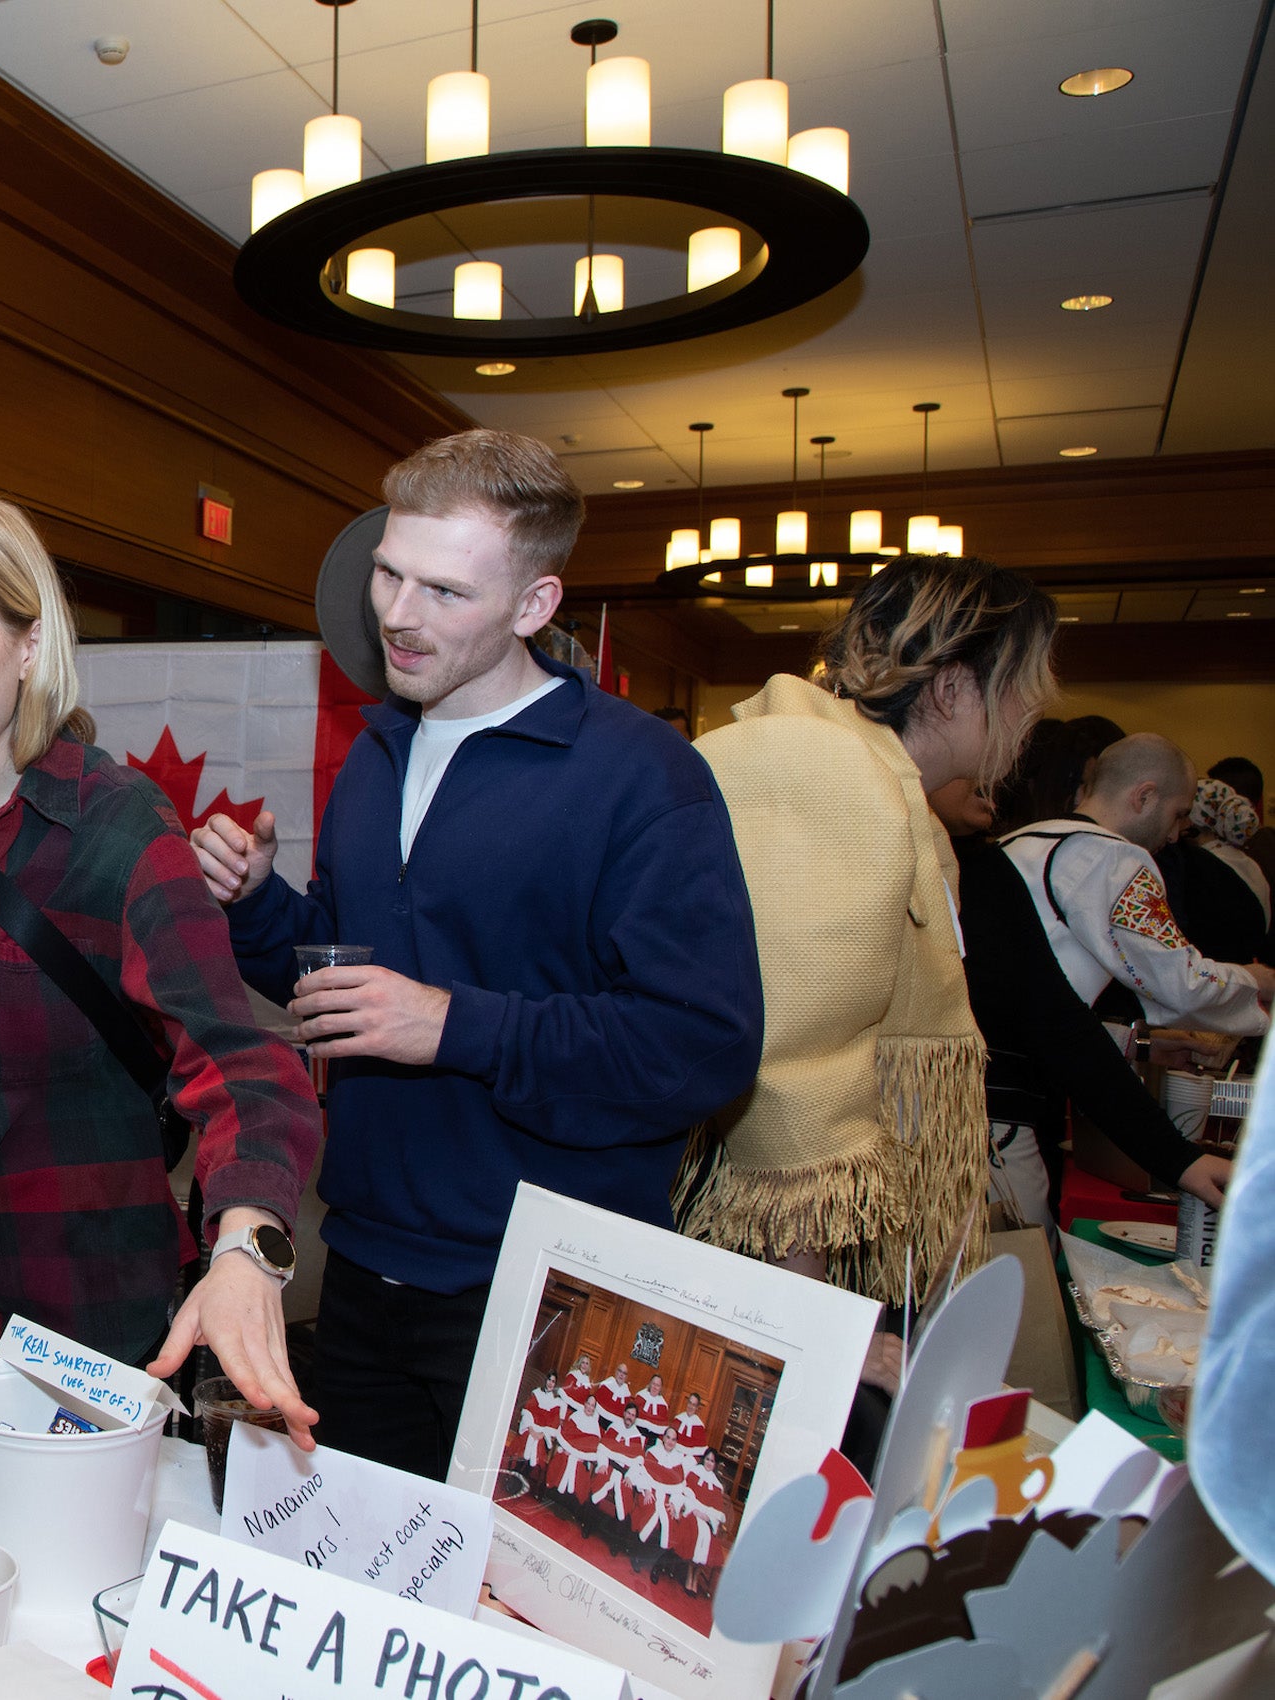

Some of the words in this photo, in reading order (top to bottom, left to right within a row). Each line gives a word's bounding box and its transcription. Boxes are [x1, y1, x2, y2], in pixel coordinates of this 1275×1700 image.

[22, 1334, 50, 1358] REAL
[53, 1351, 112, 1381] SMARTIES!
[89, 1387, 110, 1399] NOT
[243, 1473, 323, 1538] Nanaimo
[365, 1541, 394, 1580] west
[396, 1502, 431, 1546] coast
[159, 1550, 298, 1657] TAKE
[306, 1610, 345, 1685] A
